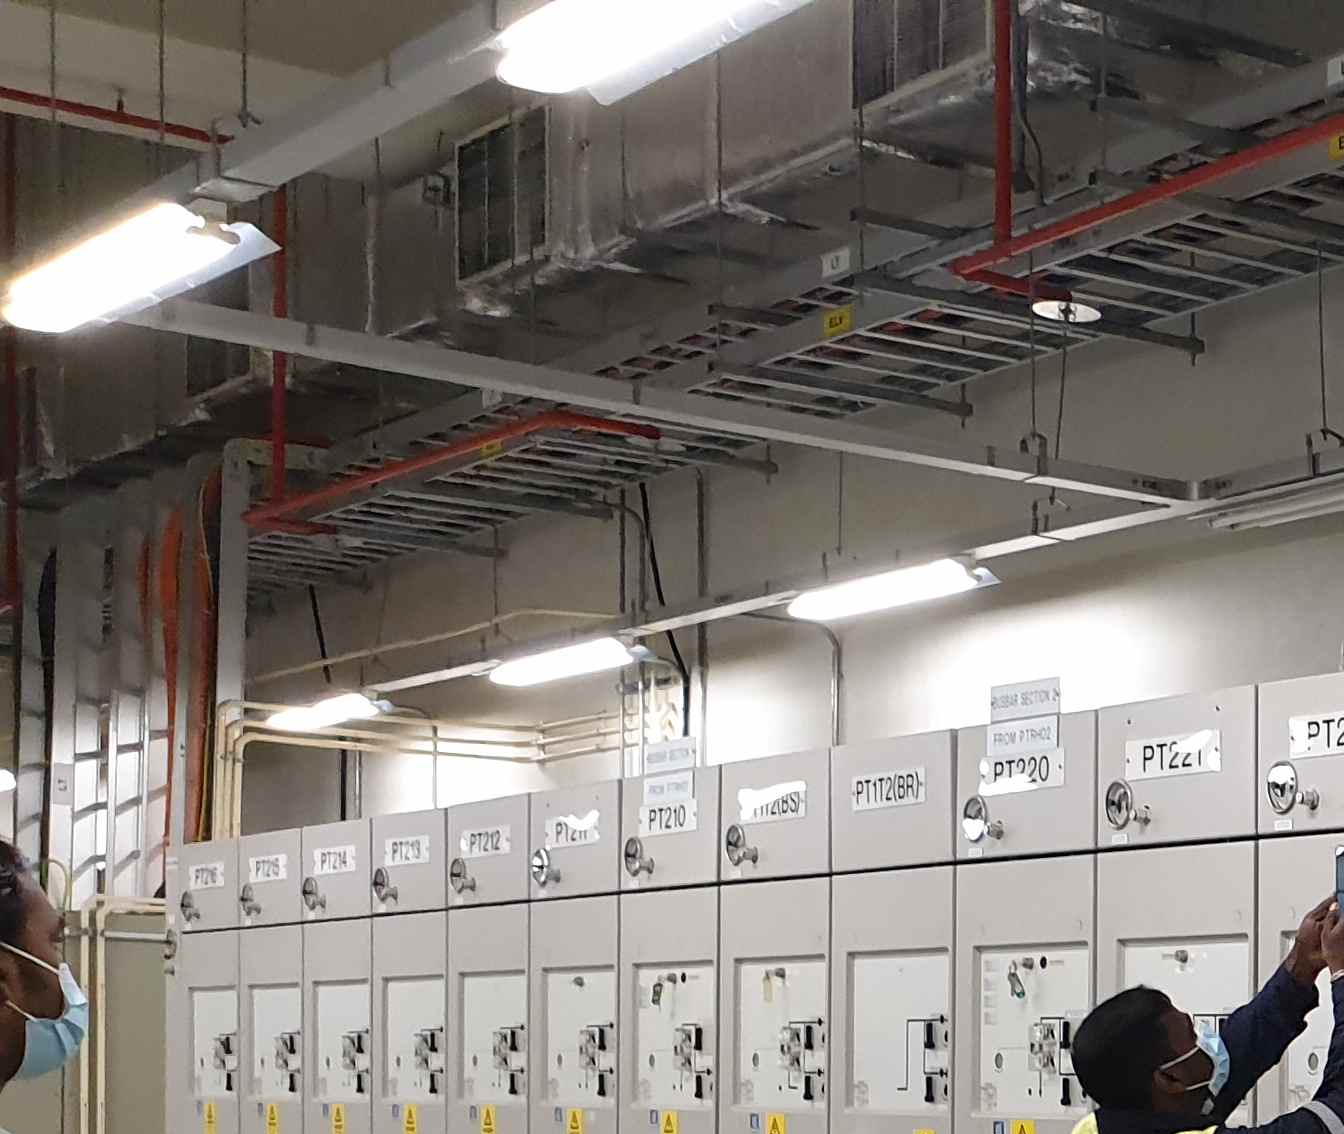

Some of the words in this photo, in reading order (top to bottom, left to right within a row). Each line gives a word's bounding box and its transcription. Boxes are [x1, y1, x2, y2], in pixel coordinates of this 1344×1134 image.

[994, 754, 1049, 784] PT220
[856, 773, 920, 805] PT1T2(BR)
[649, 804, 686, 831] PT210
[391, 839, 421, 861] PT213
[469, 830, 501, 852] PT212
[320, 851, 347, 870] PT214
